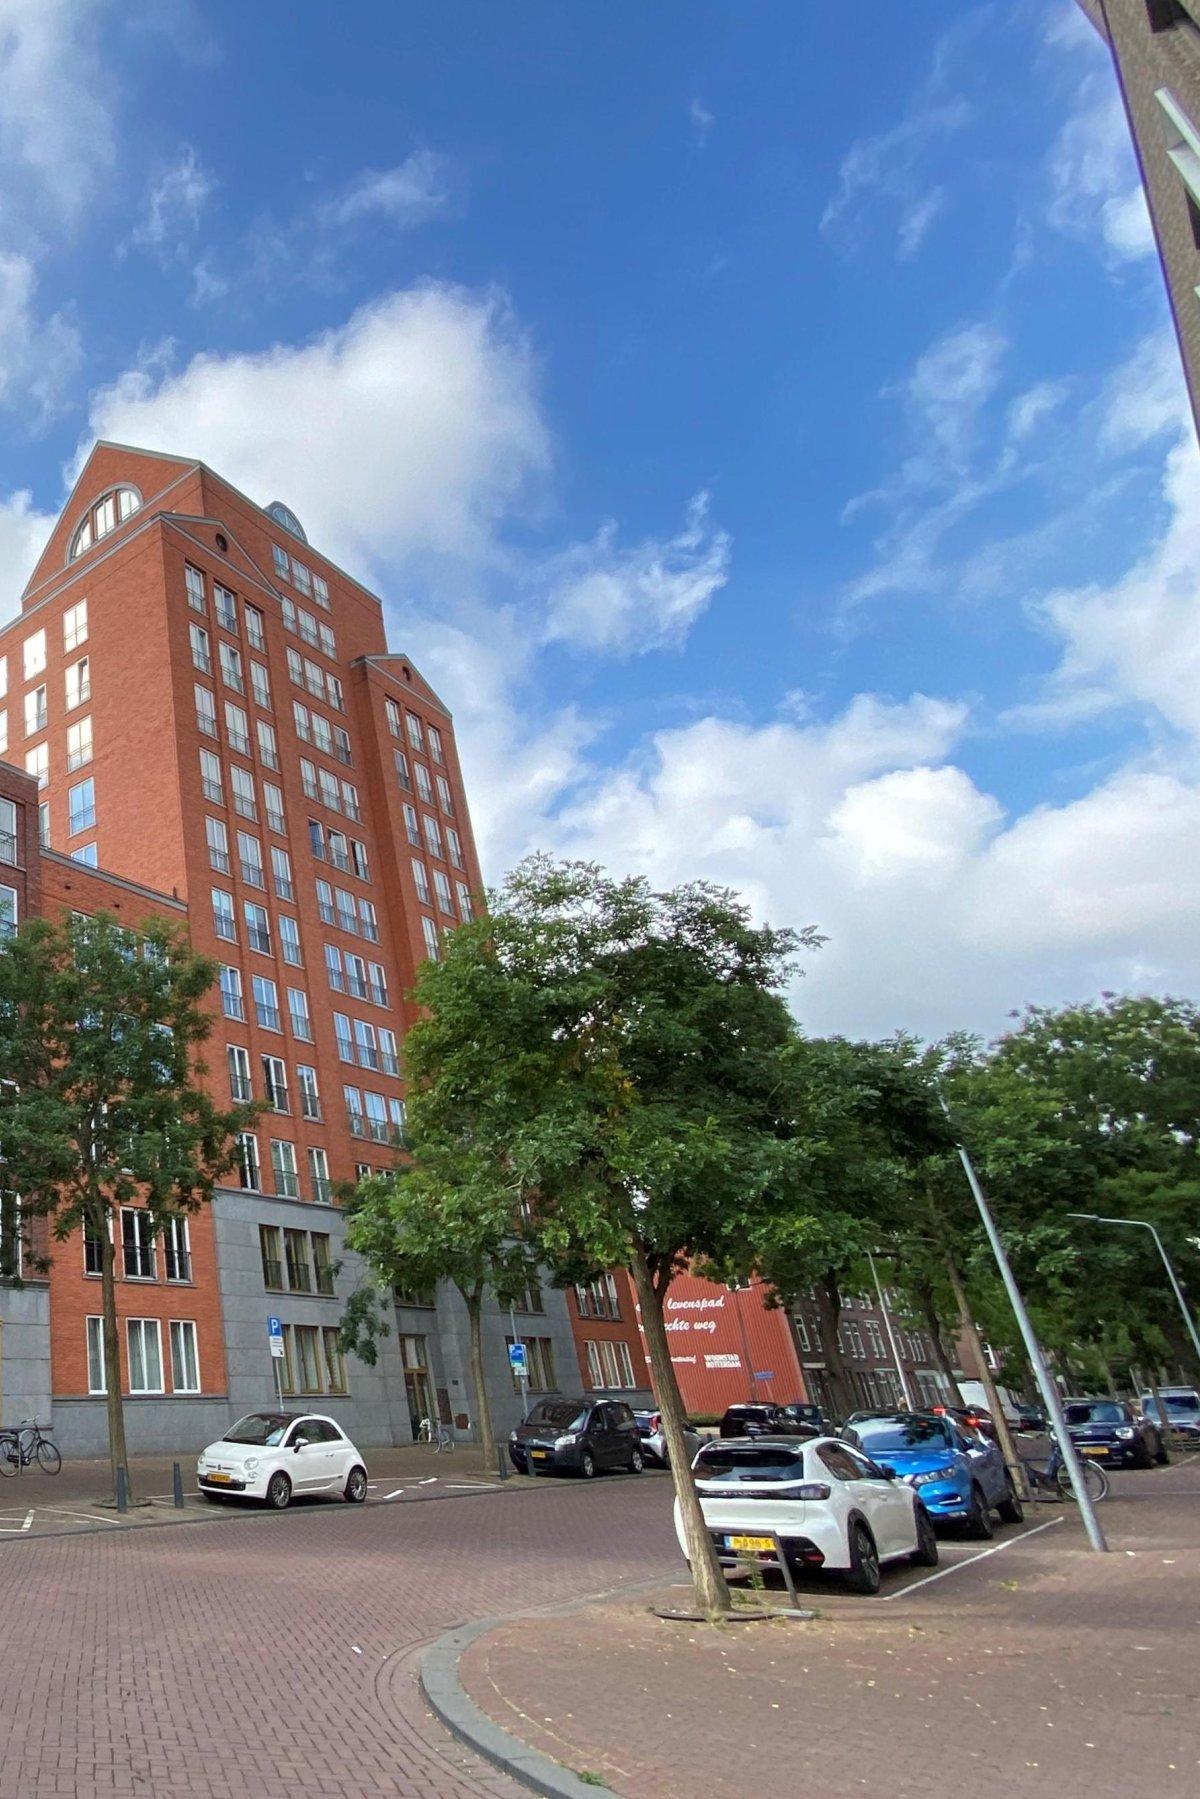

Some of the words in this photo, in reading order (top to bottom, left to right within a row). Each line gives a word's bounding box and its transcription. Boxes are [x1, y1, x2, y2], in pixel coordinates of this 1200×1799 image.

[667, 1295, 725, 1312] levenspad
[271, 1319, 278, 1334] P
[693, 1319, 717, 1334] weg
